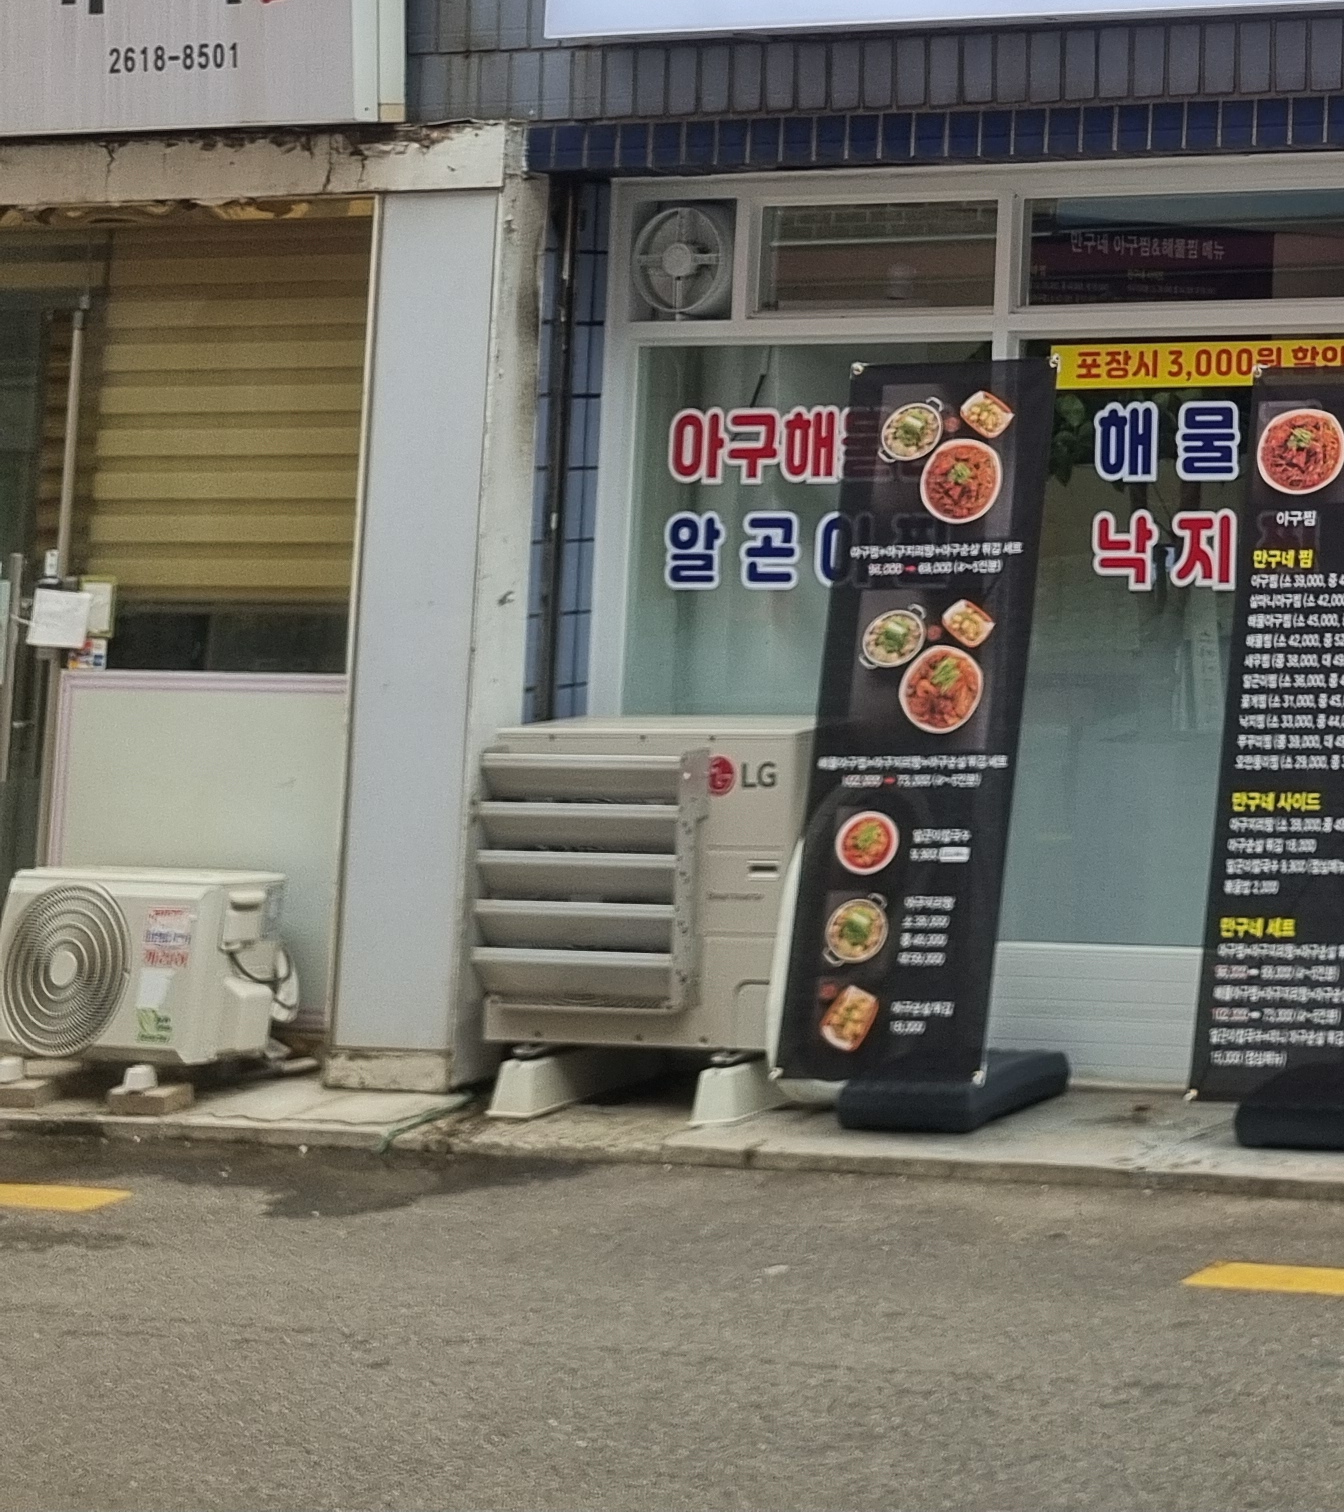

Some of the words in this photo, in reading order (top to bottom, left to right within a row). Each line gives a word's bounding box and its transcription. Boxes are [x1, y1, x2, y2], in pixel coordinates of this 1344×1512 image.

[109, 43, 238, 74] 2618-8501
[1075, 350, 1159, 380] 포장시
[1098, 405, 1238, 480] 해물
[1276, 511, 1317, 527] 아구찜
[1253, 550, 1296, 569] 만구네
[1299, 549, 1315, 568] 찜
[741, 761, 777, 788] LG
